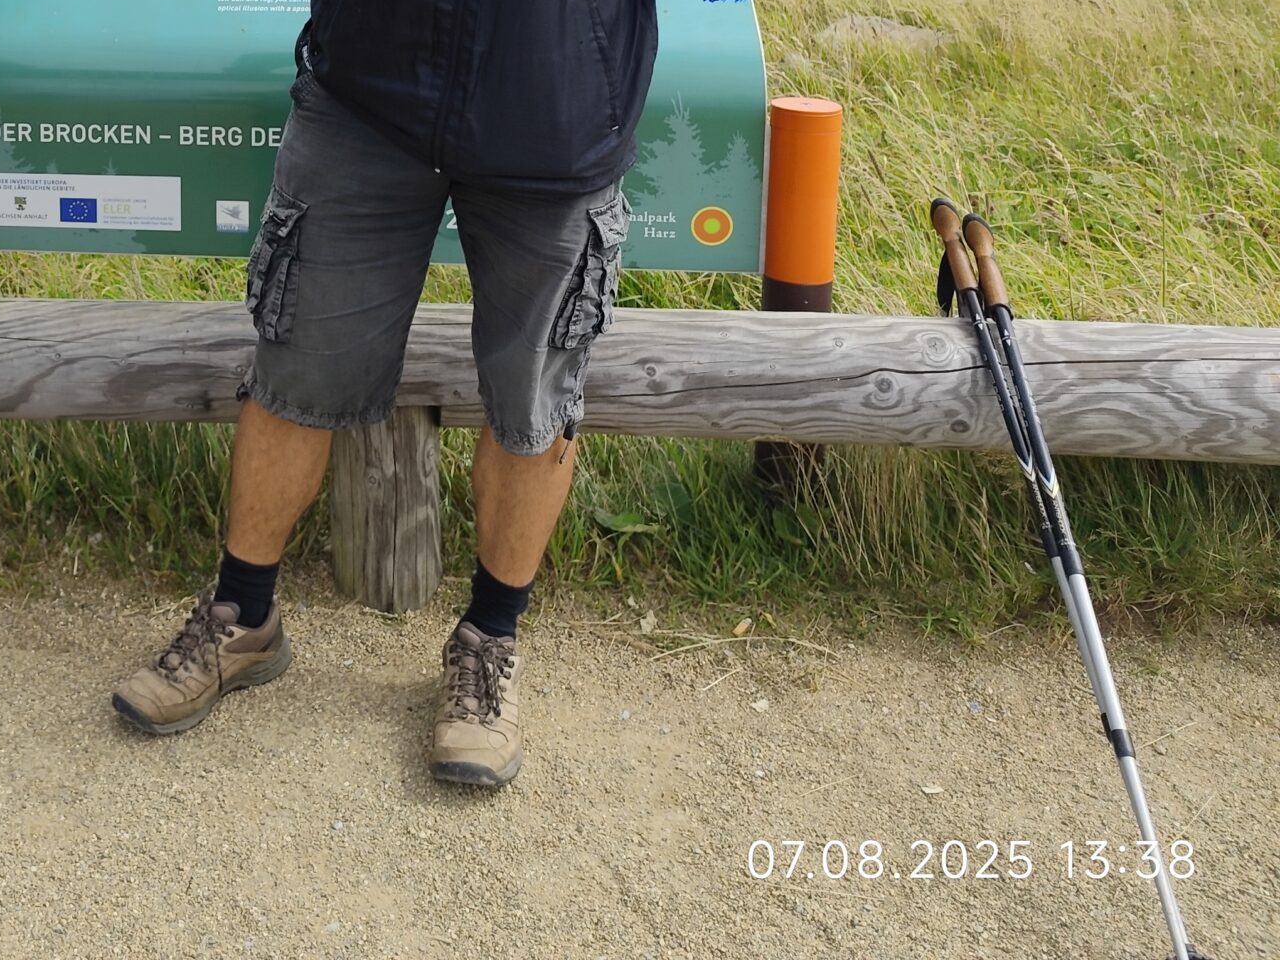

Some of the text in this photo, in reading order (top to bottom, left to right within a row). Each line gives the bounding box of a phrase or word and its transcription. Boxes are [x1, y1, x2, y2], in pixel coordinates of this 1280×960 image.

[40, 123, 151, 144] BROCKEN
[180, 126, 243, 146] BERG
[644, 226, 676, 239] Harz
